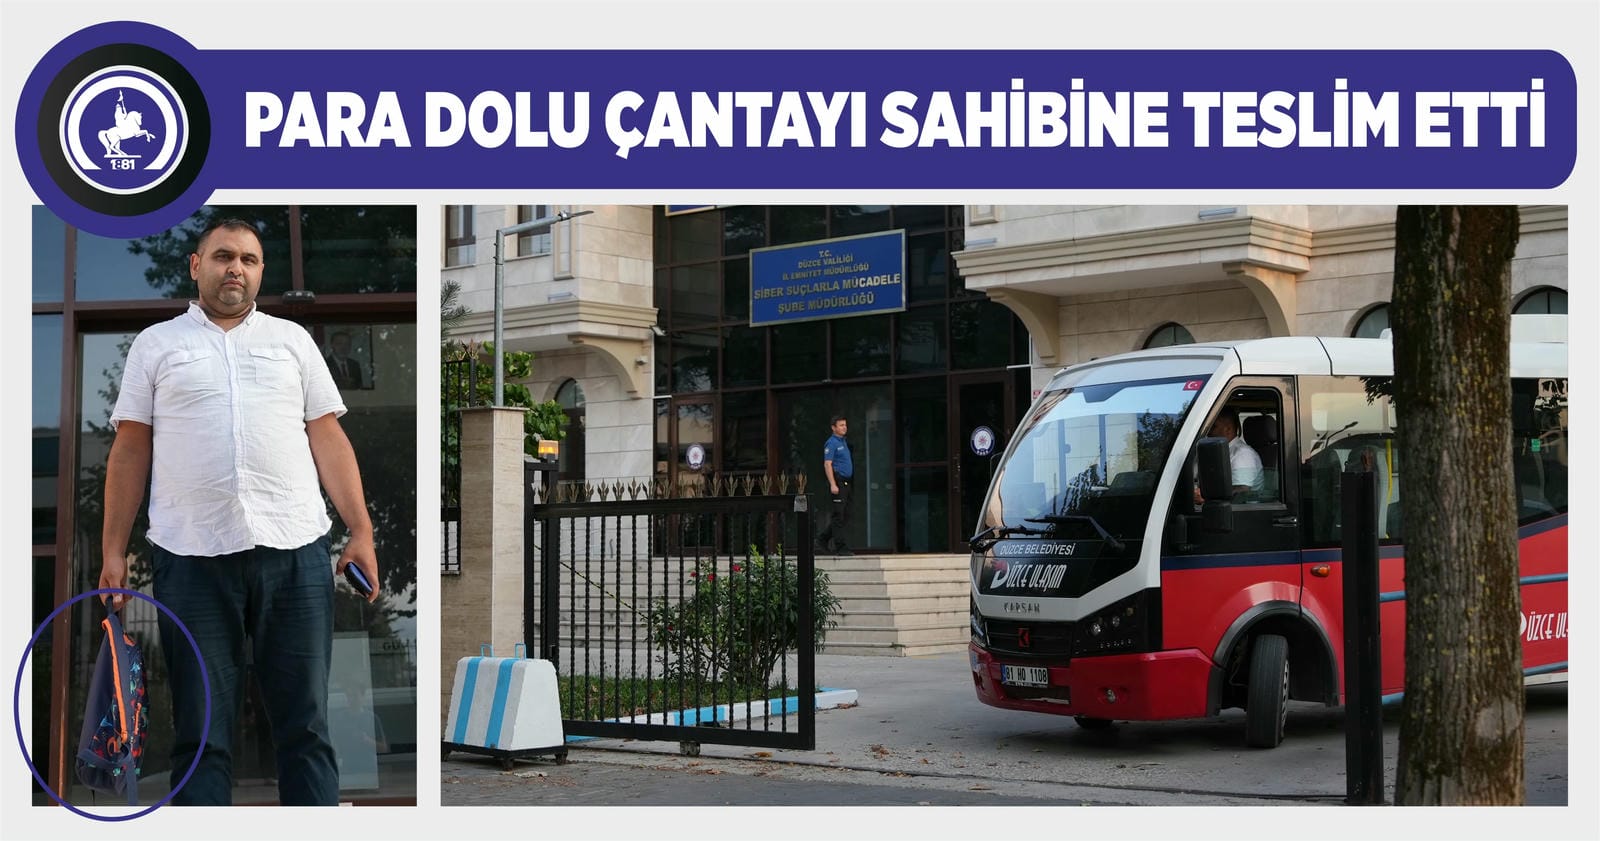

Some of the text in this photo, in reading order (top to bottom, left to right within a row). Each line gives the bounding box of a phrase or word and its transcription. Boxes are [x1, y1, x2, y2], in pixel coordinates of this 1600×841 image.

[818, 250, 832, 258] T.C.
[798, 259, 822, 269] DÜZCE
[754, 273, 901, 300] SİBER SUÇLARLA MÜCADELE
[778, 292, 874, 315] ŞUBE MÜDÜRLÜĞÜ
[1000, 542, 1076, 556] DÜZCE BELEDİYESİ
[1028, 564, 1067, 592] ULAŞIM
[1006, 666, 1014, 680] 81
[1030, 668, 1047, 683] 1108
